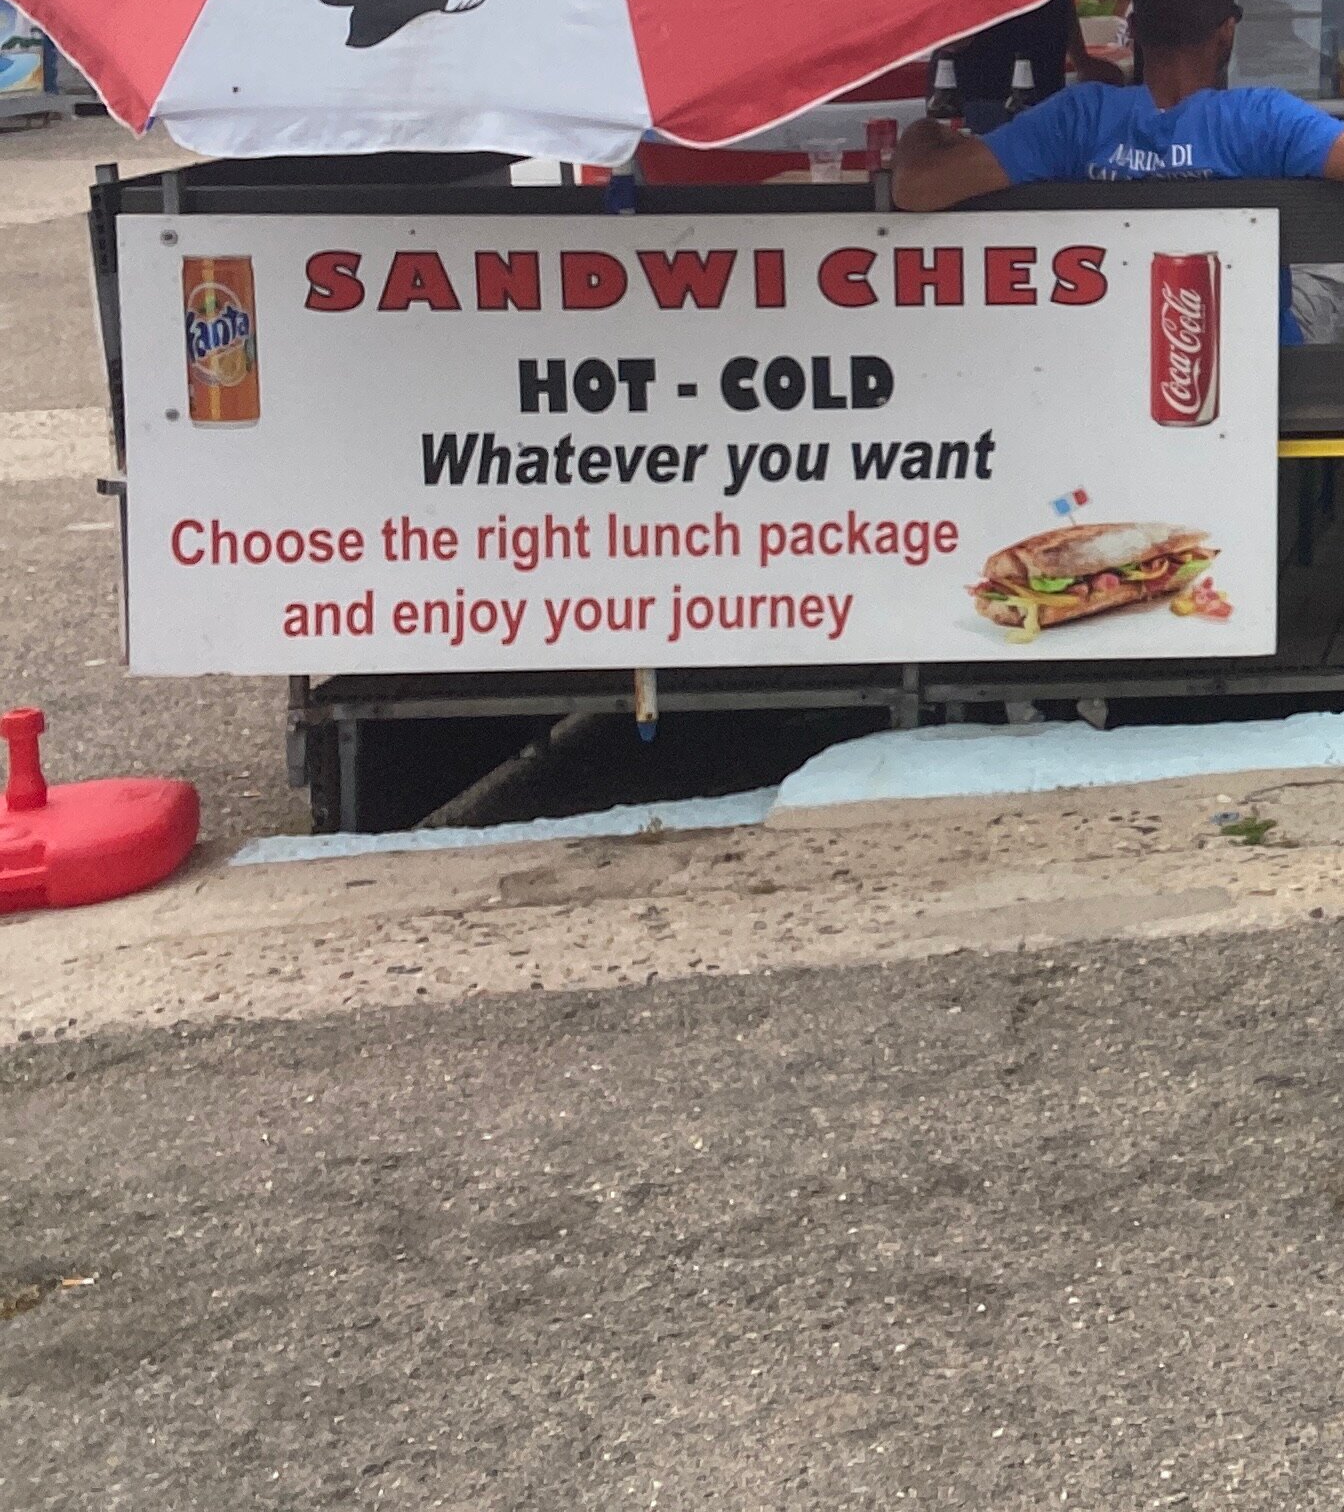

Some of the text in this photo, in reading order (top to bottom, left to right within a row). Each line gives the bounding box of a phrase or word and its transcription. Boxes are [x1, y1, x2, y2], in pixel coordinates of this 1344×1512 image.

[1172, 144, 1193, 166] DI
[305, 244, 1109, 314] SANDWICHES
[519, 357, 656, 413] HOT
[721, 355, 894, 411] COLD
[419, 431, 995, 496] Whatever you want
[170, 508, 960, 574] Choose the right lunch package
[282, 585, 855, 646] and enjoy your journey
